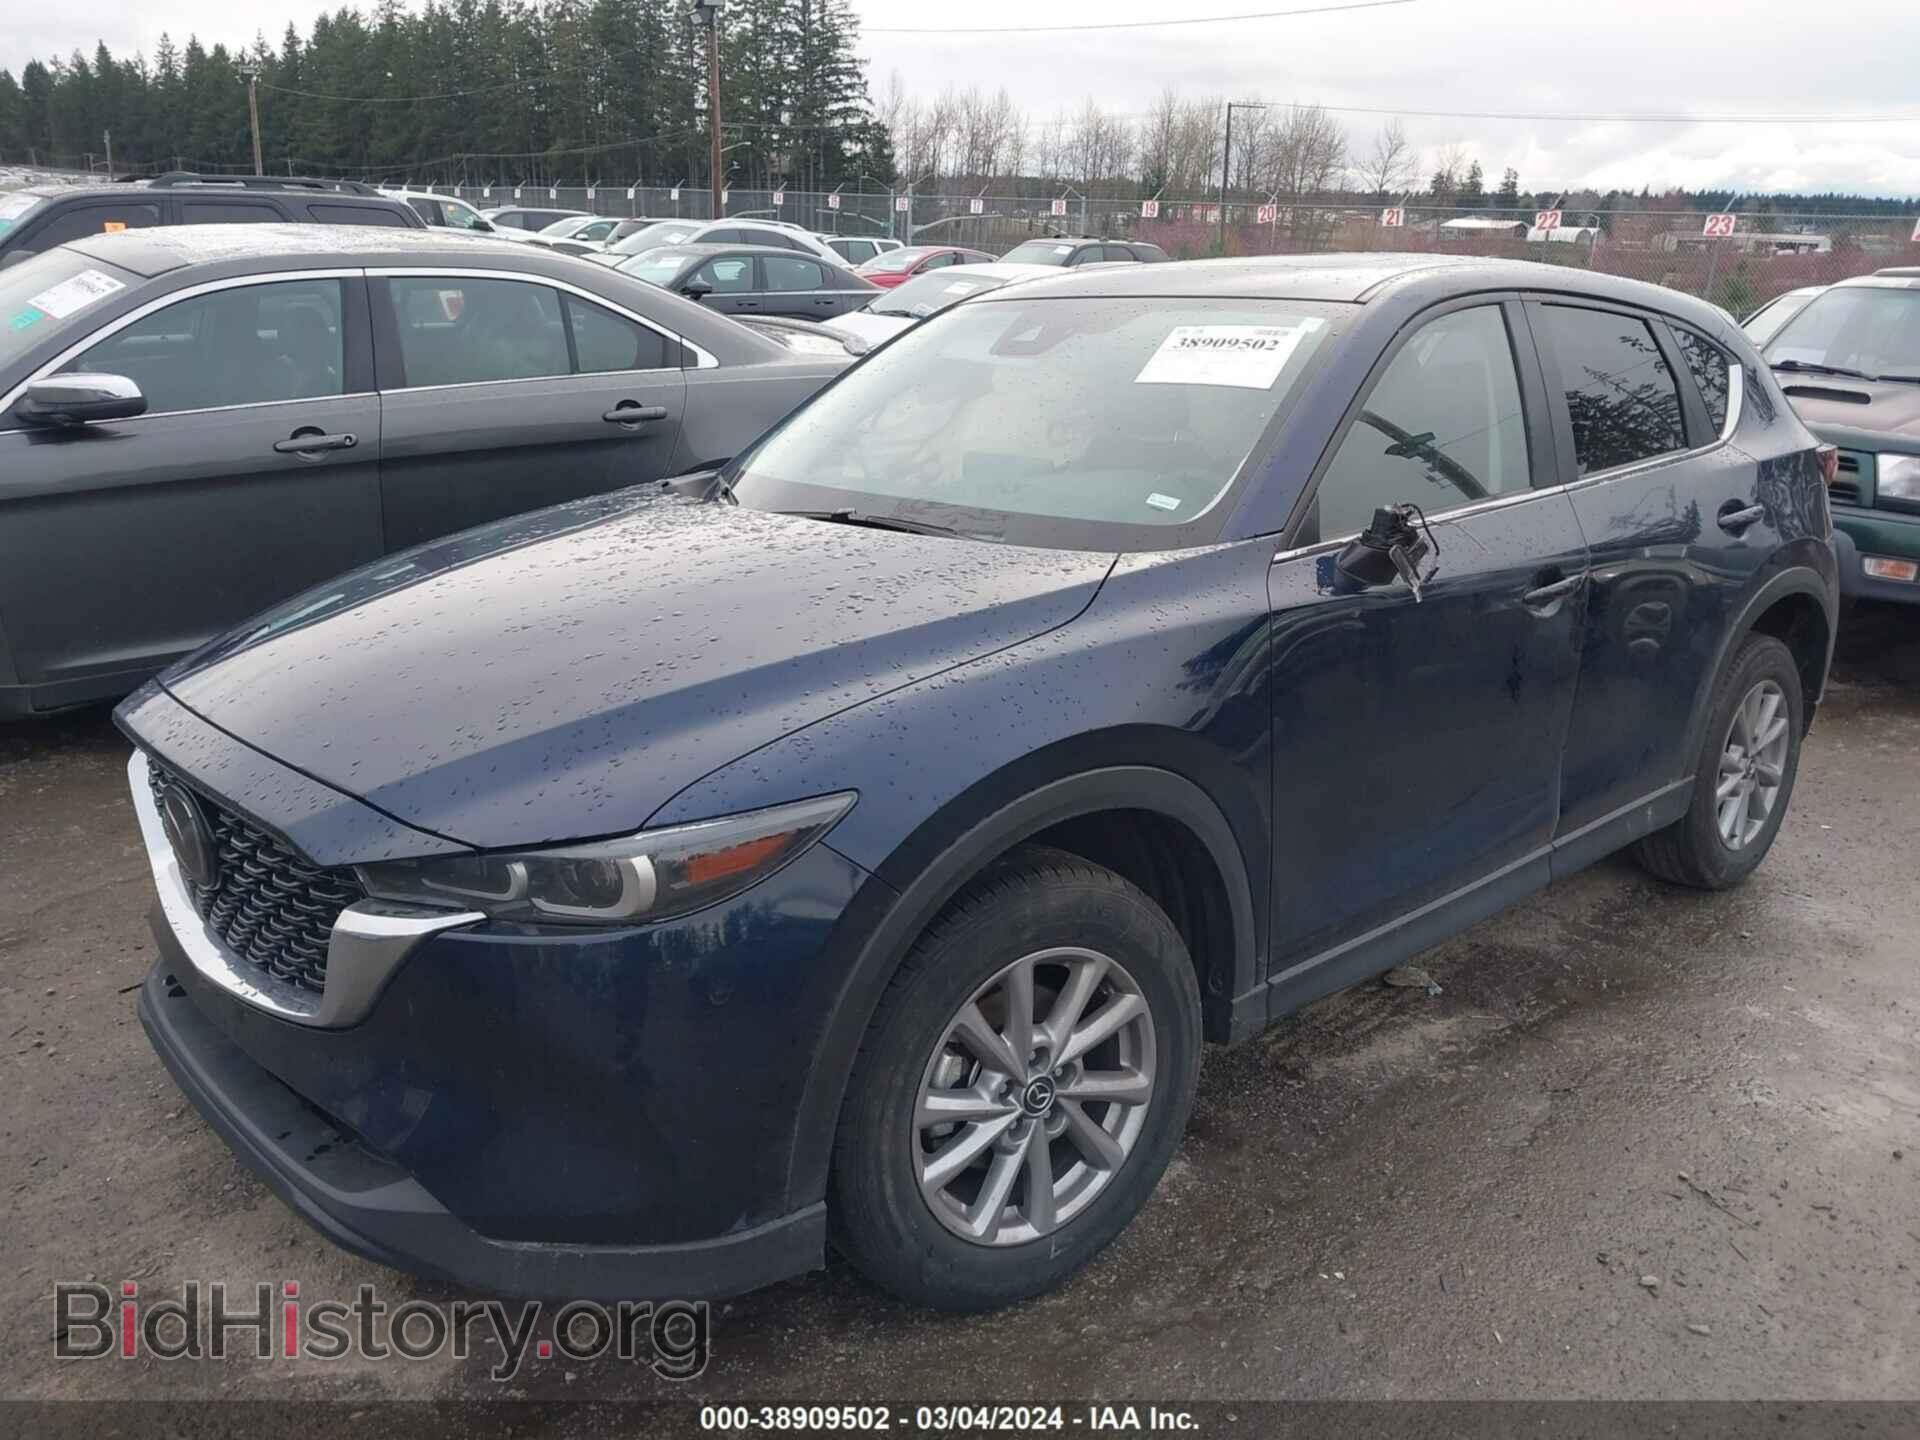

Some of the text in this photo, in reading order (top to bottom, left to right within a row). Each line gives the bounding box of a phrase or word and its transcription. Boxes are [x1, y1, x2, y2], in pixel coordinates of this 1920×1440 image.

[1259, 206, 1275, 222] 20
[1386, 209, 1400, 225] 21
[1537, 212, 1559, 230] 22
[1705, 215, 1732, 235] 23
[1173, 337, 1280, 351] 38909502
